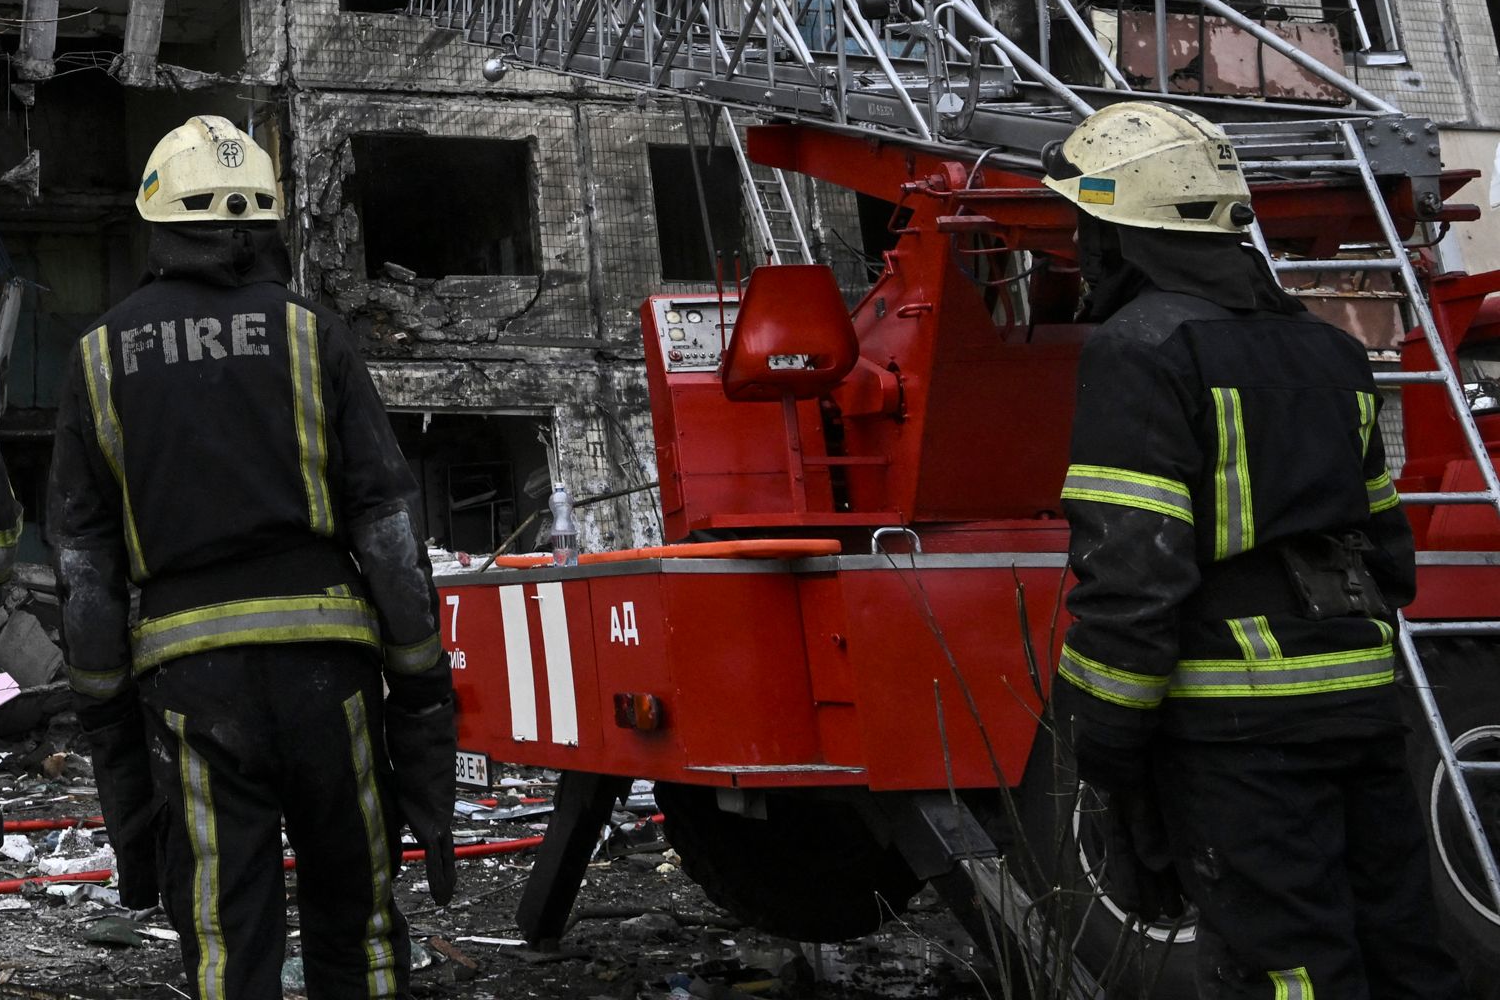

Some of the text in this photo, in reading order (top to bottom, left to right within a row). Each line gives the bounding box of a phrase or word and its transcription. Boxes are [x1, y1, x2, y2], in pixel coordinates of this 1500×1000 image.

[222, 143, 239, 156] 25
[224, 155, 237, 167] 11
[1217, 144, 1232, 160] 25
[120, 312, 270, 376] FIRE
[446, 595, 460, 642] 7
[610, 601, 640, 646] АД
